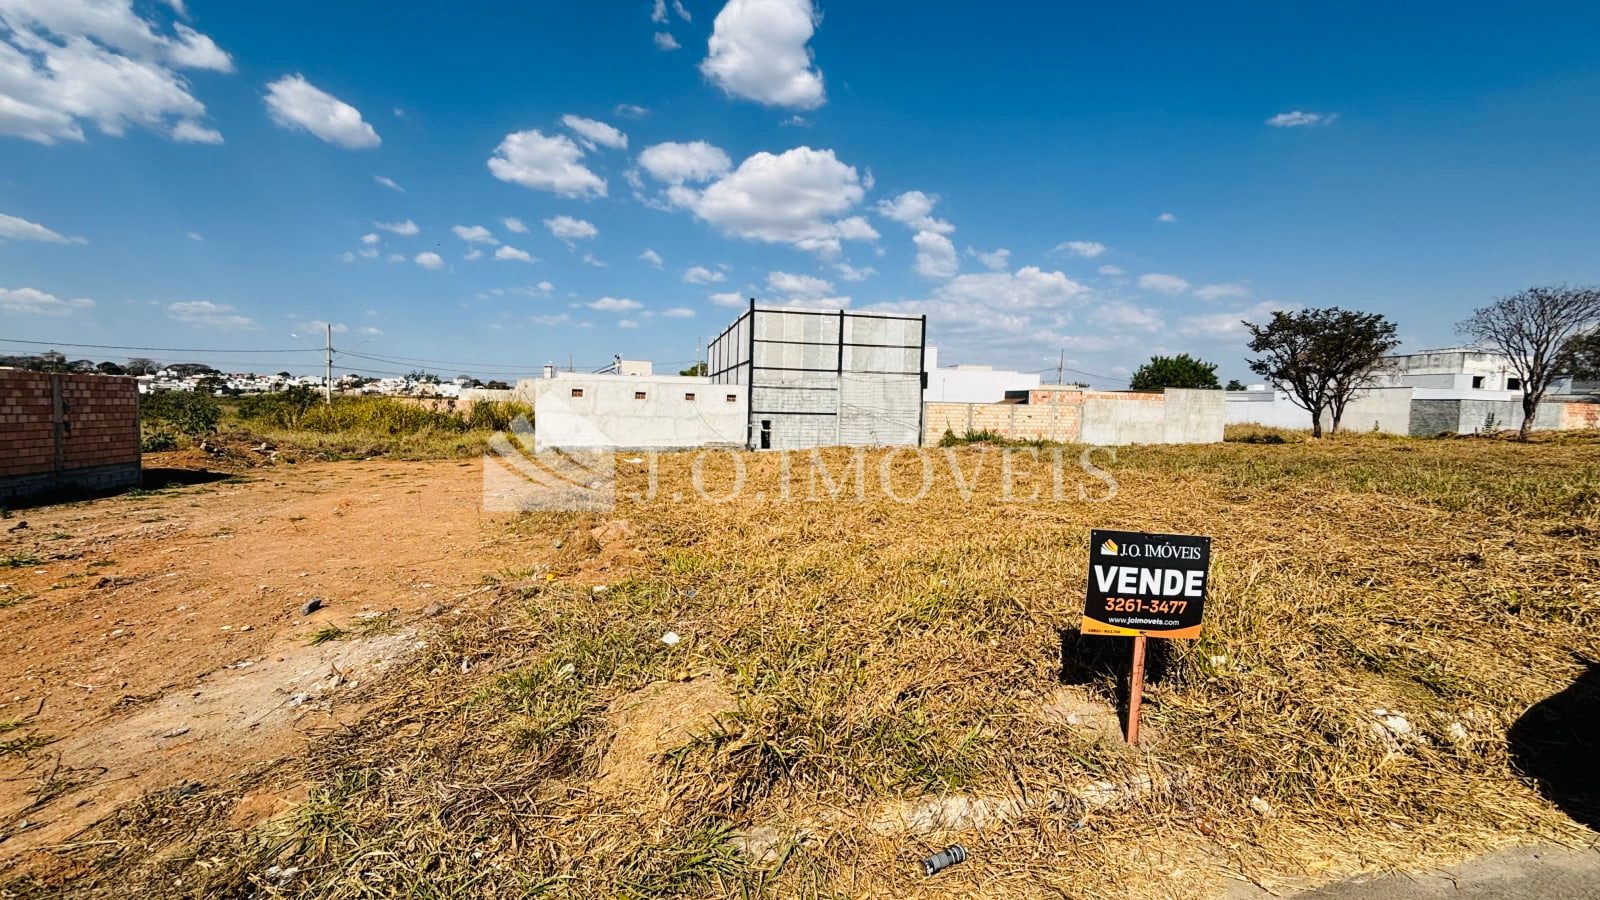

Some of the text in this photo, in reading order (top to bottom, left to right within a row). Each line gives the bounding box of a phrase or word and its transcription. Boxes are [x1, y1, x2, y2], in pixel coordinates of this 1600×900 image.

[1120, 541, 1201, 560] J.O. IMÓVEIS
[1094, 564, 1204, 597] VENDE
[1105, 597, 1187, 615] 3261-3477
[1108, 616, 1180, 626] www.joimoveis.com
